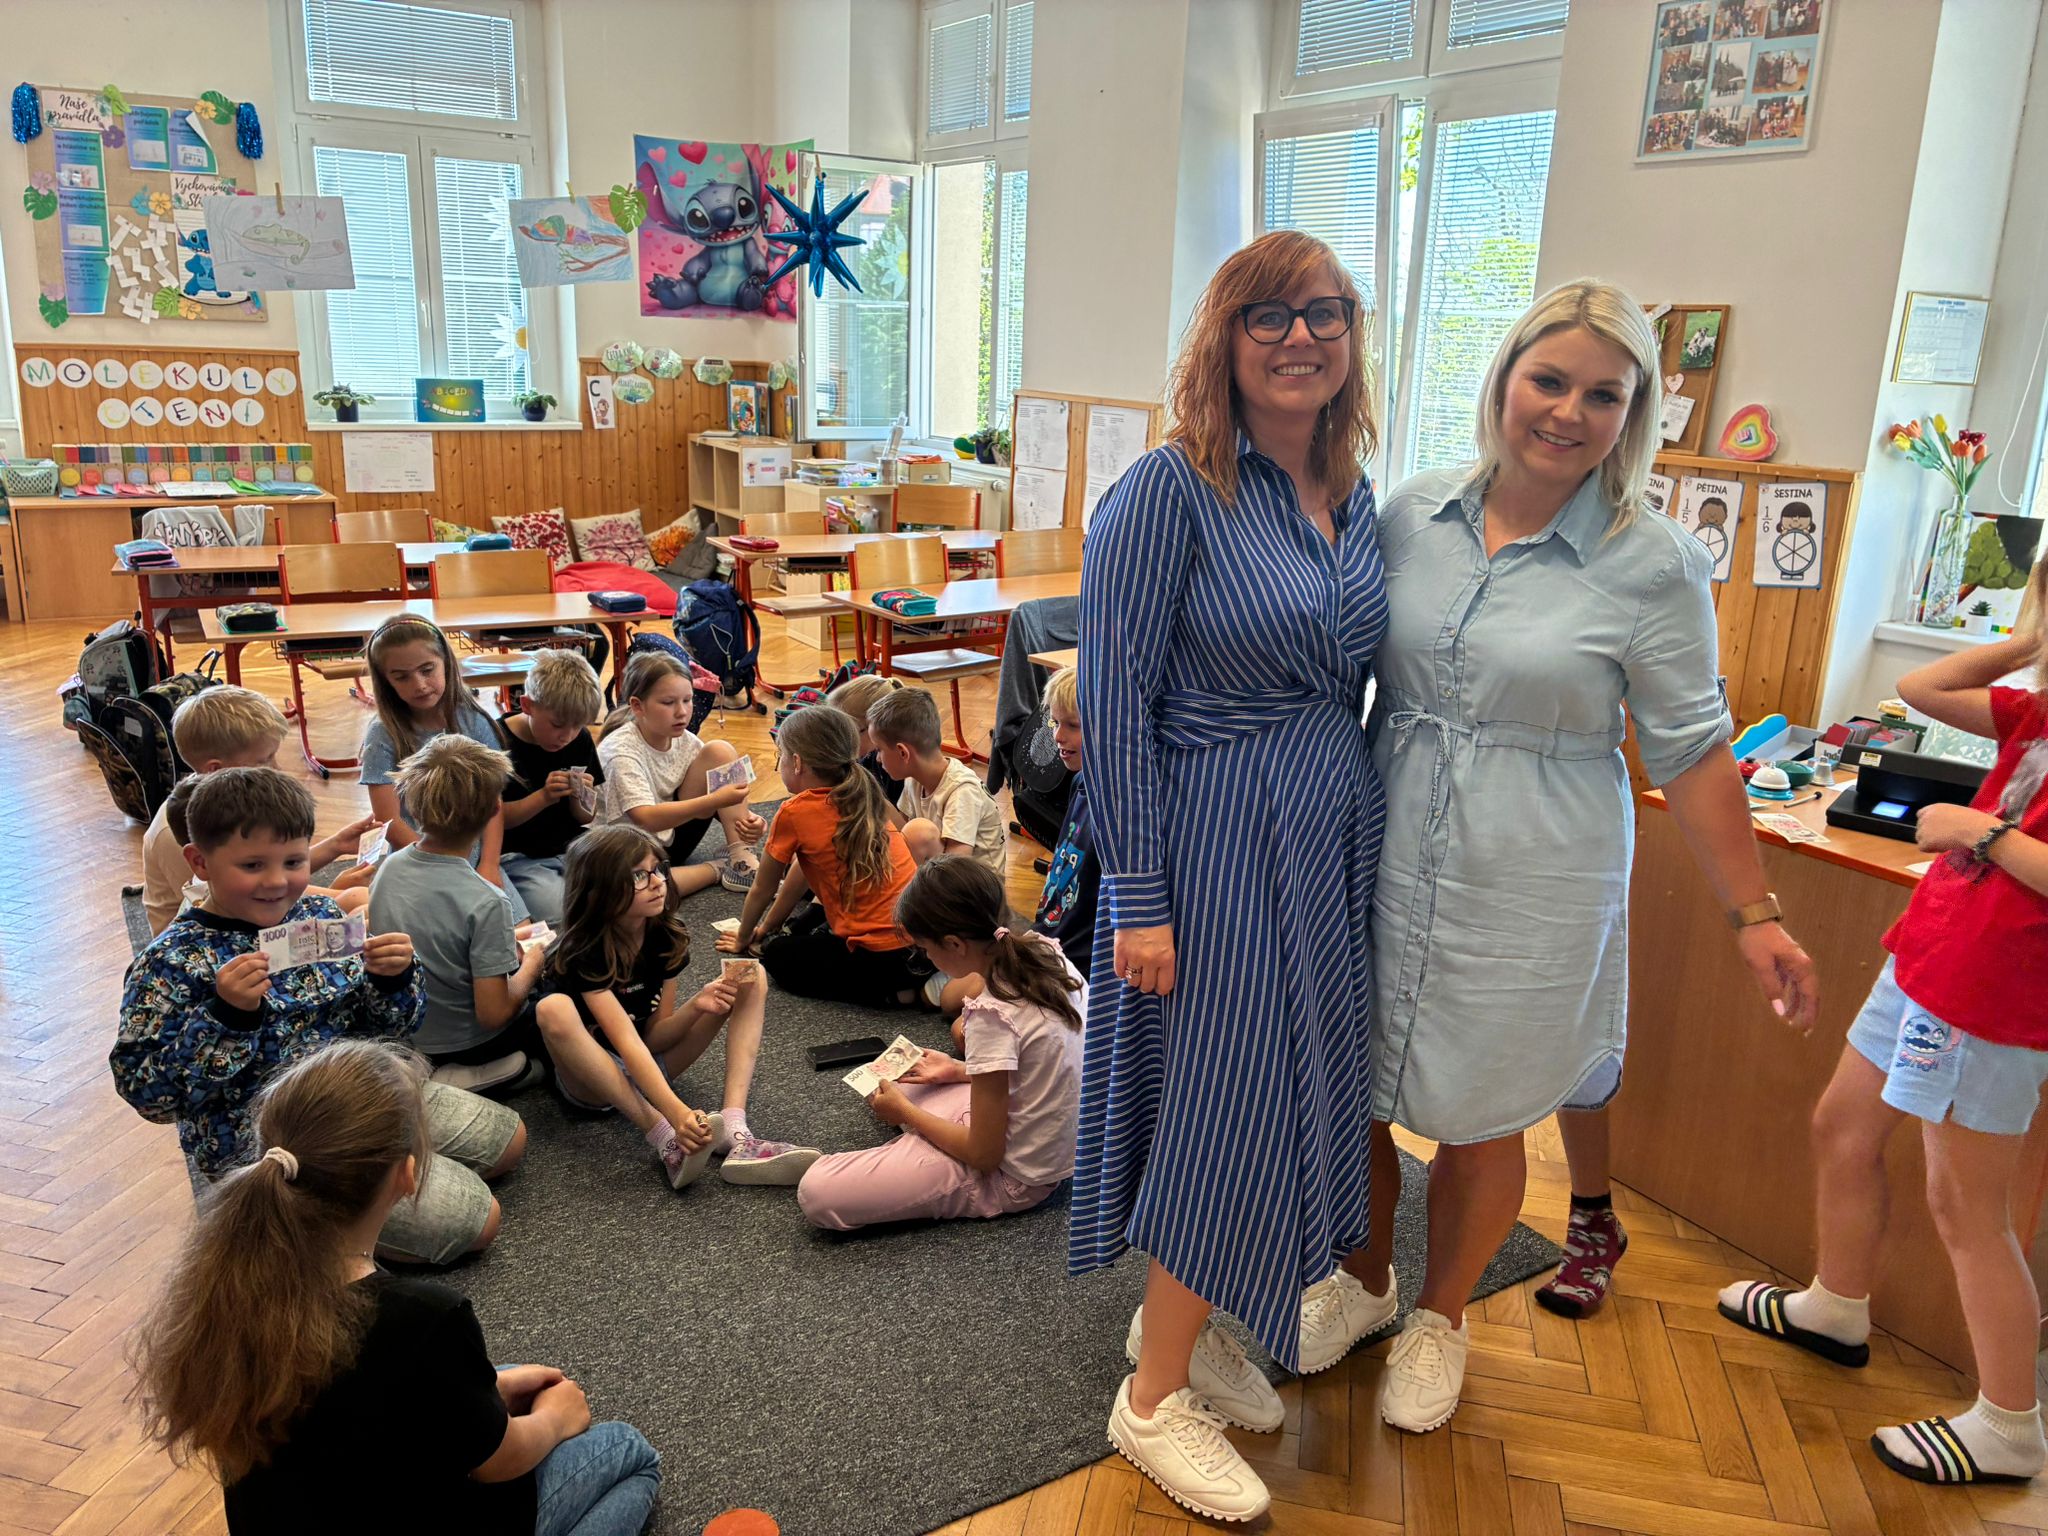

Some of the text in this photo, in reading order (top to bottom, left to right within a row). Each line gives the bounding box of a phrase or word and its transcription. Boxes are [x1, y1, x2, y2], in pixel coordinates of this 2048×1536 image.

[60, 94, 87, 110] Naše
[48, 108, 101, 123] pravidla
[25, 361, 287, 391] MOLEKULY
[589, 380, 601, 397] C
[1648, 477, 1665, 490] INA
[1774, 487, 1813, 498] ŠESTINA
[263, 927, 287, 943] 1000
[847, 1069, 864, 1082] 500
